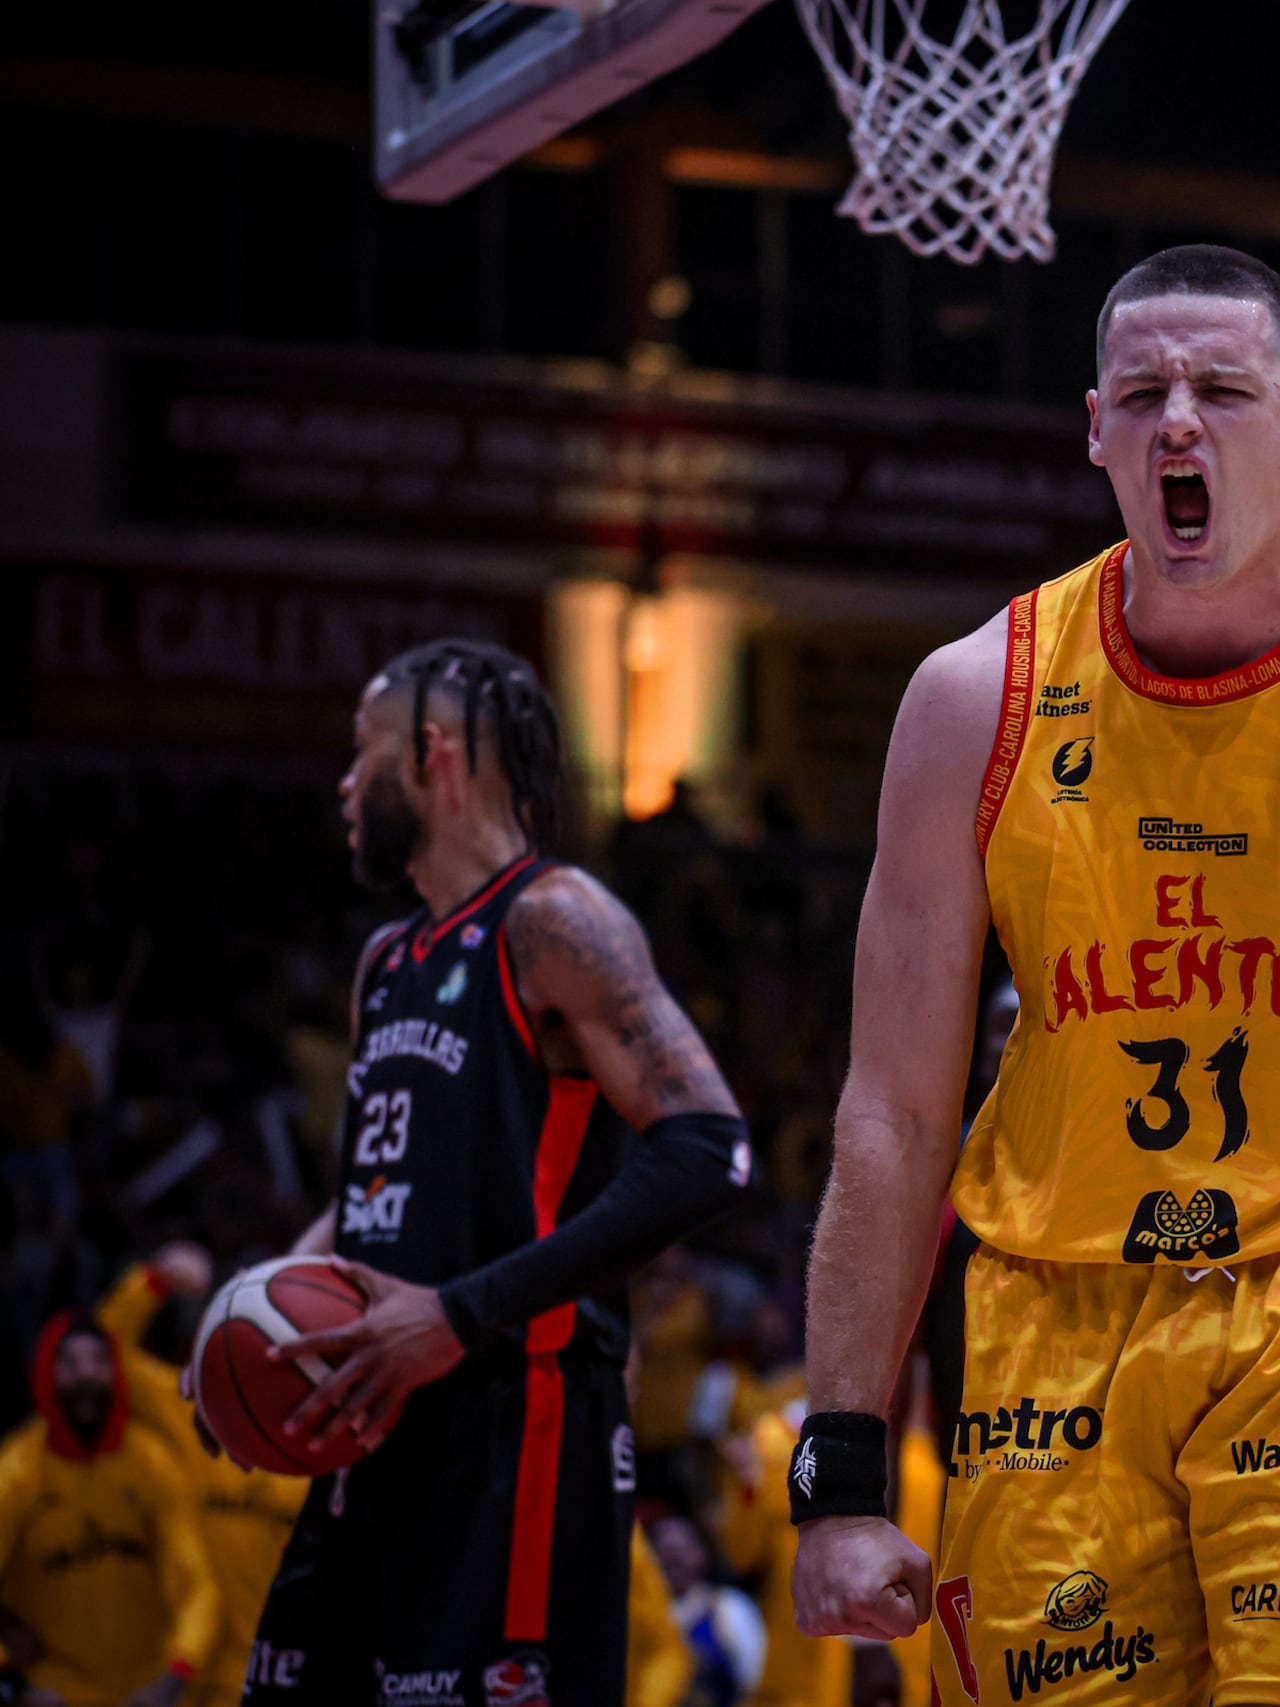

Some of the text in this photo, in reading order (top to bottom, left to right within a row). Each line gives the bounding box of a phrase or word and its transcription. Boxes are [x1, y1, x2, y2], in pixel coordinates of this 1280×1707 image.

[984, 691, 1026, 799] CLUB-CAROLINA
[1011, 597, 1032, 688] HOUSING-CAROL
[1041, 681, 1080, 699] anet
[1180, 685, 1194, 699] DE
[1035, 700, 1089, 717] itness
[1142, 821, 1203, 834] UNITED
[1143, 837, 1244, 852] COLLECTION
[1155, 872, 1224, 930] EL
[1117, 1026, 1250, 1163] 31
[355, 1090, 411, 1165] 23
[965, 1459, 983, 1483] by
[1004, 1620, 1155, 1701] Wendy's
